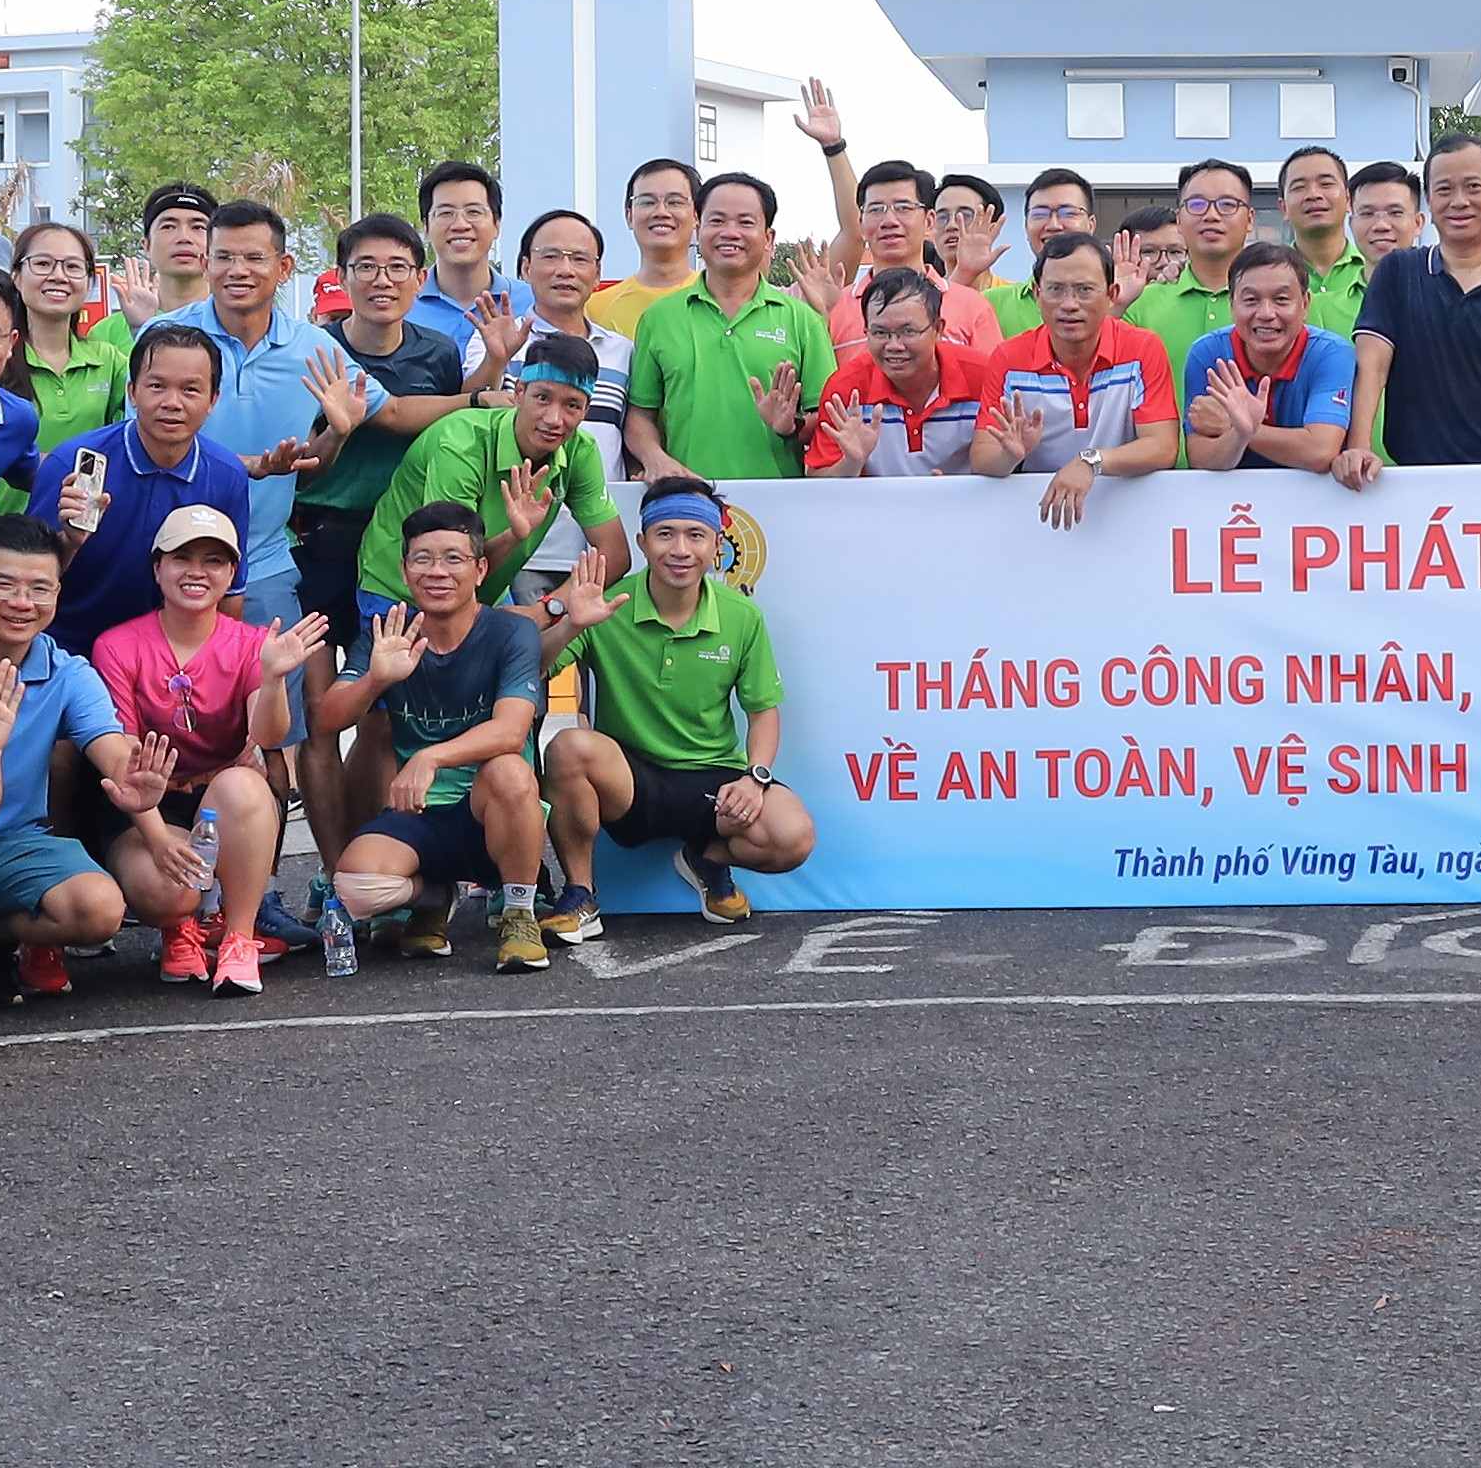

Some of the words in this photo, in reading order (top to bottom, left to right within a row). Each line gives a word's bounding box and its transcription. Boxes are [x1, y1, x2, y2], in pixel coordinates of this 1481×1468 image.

[1172, 503, 1263, 594] LỄ
[878, 648, 1080, 709] THÁNG
[1102, 645, 1264, 706] CÔNG
[1287, 642, 1471, 709] NHÂN,
[847, 736, 917, 801] VỀ
[939, 751, 1016, 799] AN
[1038, 736, 1212, 805] TOÀN,
[1235, 735, 1307, 805] VỆ
[1329, 744, 1466, 793] SINH
[1114, 847, 1204, 877] Thành
[1213, 843, 1276, 884] phố
[1281, 845, 1356, 882] Vũng
[1367, 843, 1426, 880] Tàu,
